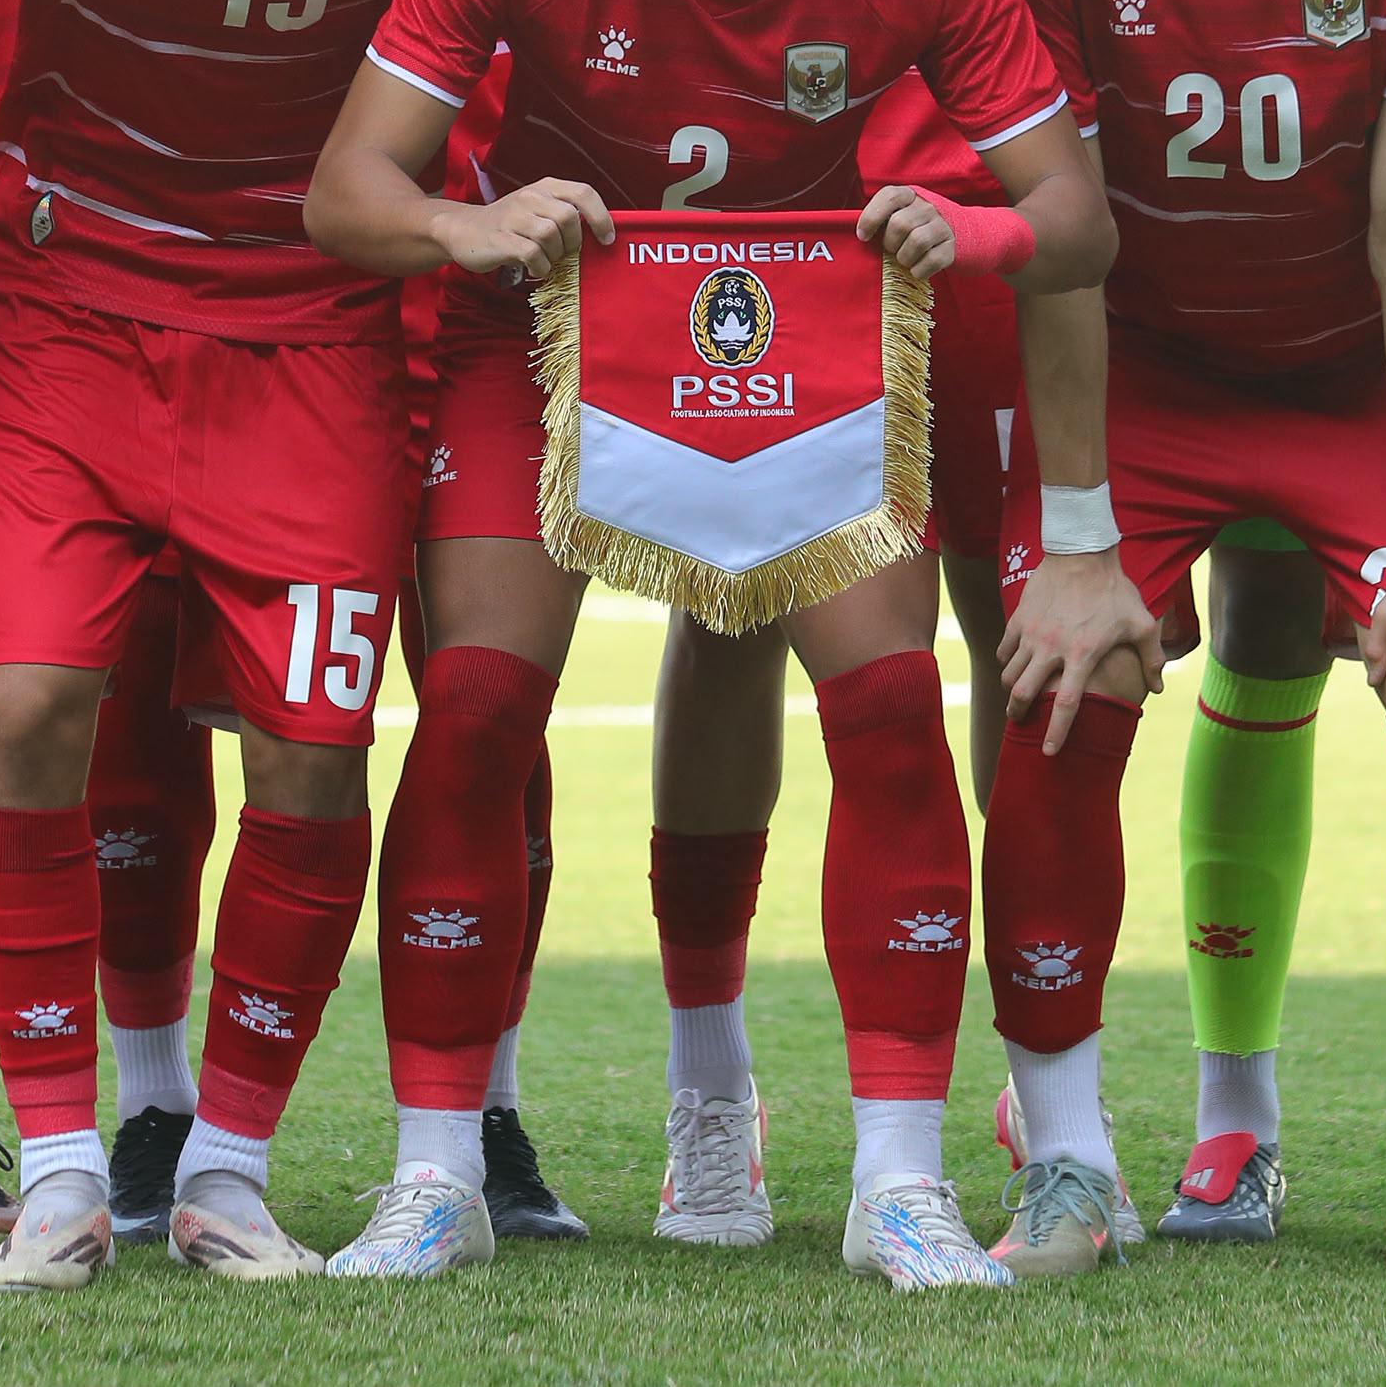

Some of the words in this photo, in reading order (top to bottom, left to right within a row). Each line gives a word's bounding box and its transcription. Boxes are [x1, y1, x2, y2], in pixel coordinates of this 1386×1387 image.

[1109, 20, 1156, 36] ELME
[585, 58, 640, 77] KELME
[1164, 73, 1302, 181] 20
[661, 125, 730, 212] 2
[628, 241, 834, 264] INDONESIA
[717, 296, 747, 310] PSSI
[672, 374, 794, 408] PSSI
[670, 409, 704, 418] FOOTBALL
[705, 409, 750, 418] ASSOCIATION
[751, 409, 759, 417] OF
[760, 408, 795, 417] INDONESIA
[285, 583, 380, 711] 15
[96, 856, 157, 870] ELME
[403, 933, 481, 949] KELME
[888, 938, 963, 952] KELME
[1012, 970, 1083, 991] KELME
[12, 1024, 78, 1039] KELME
[229, 1007, 294, 1039] KELME
